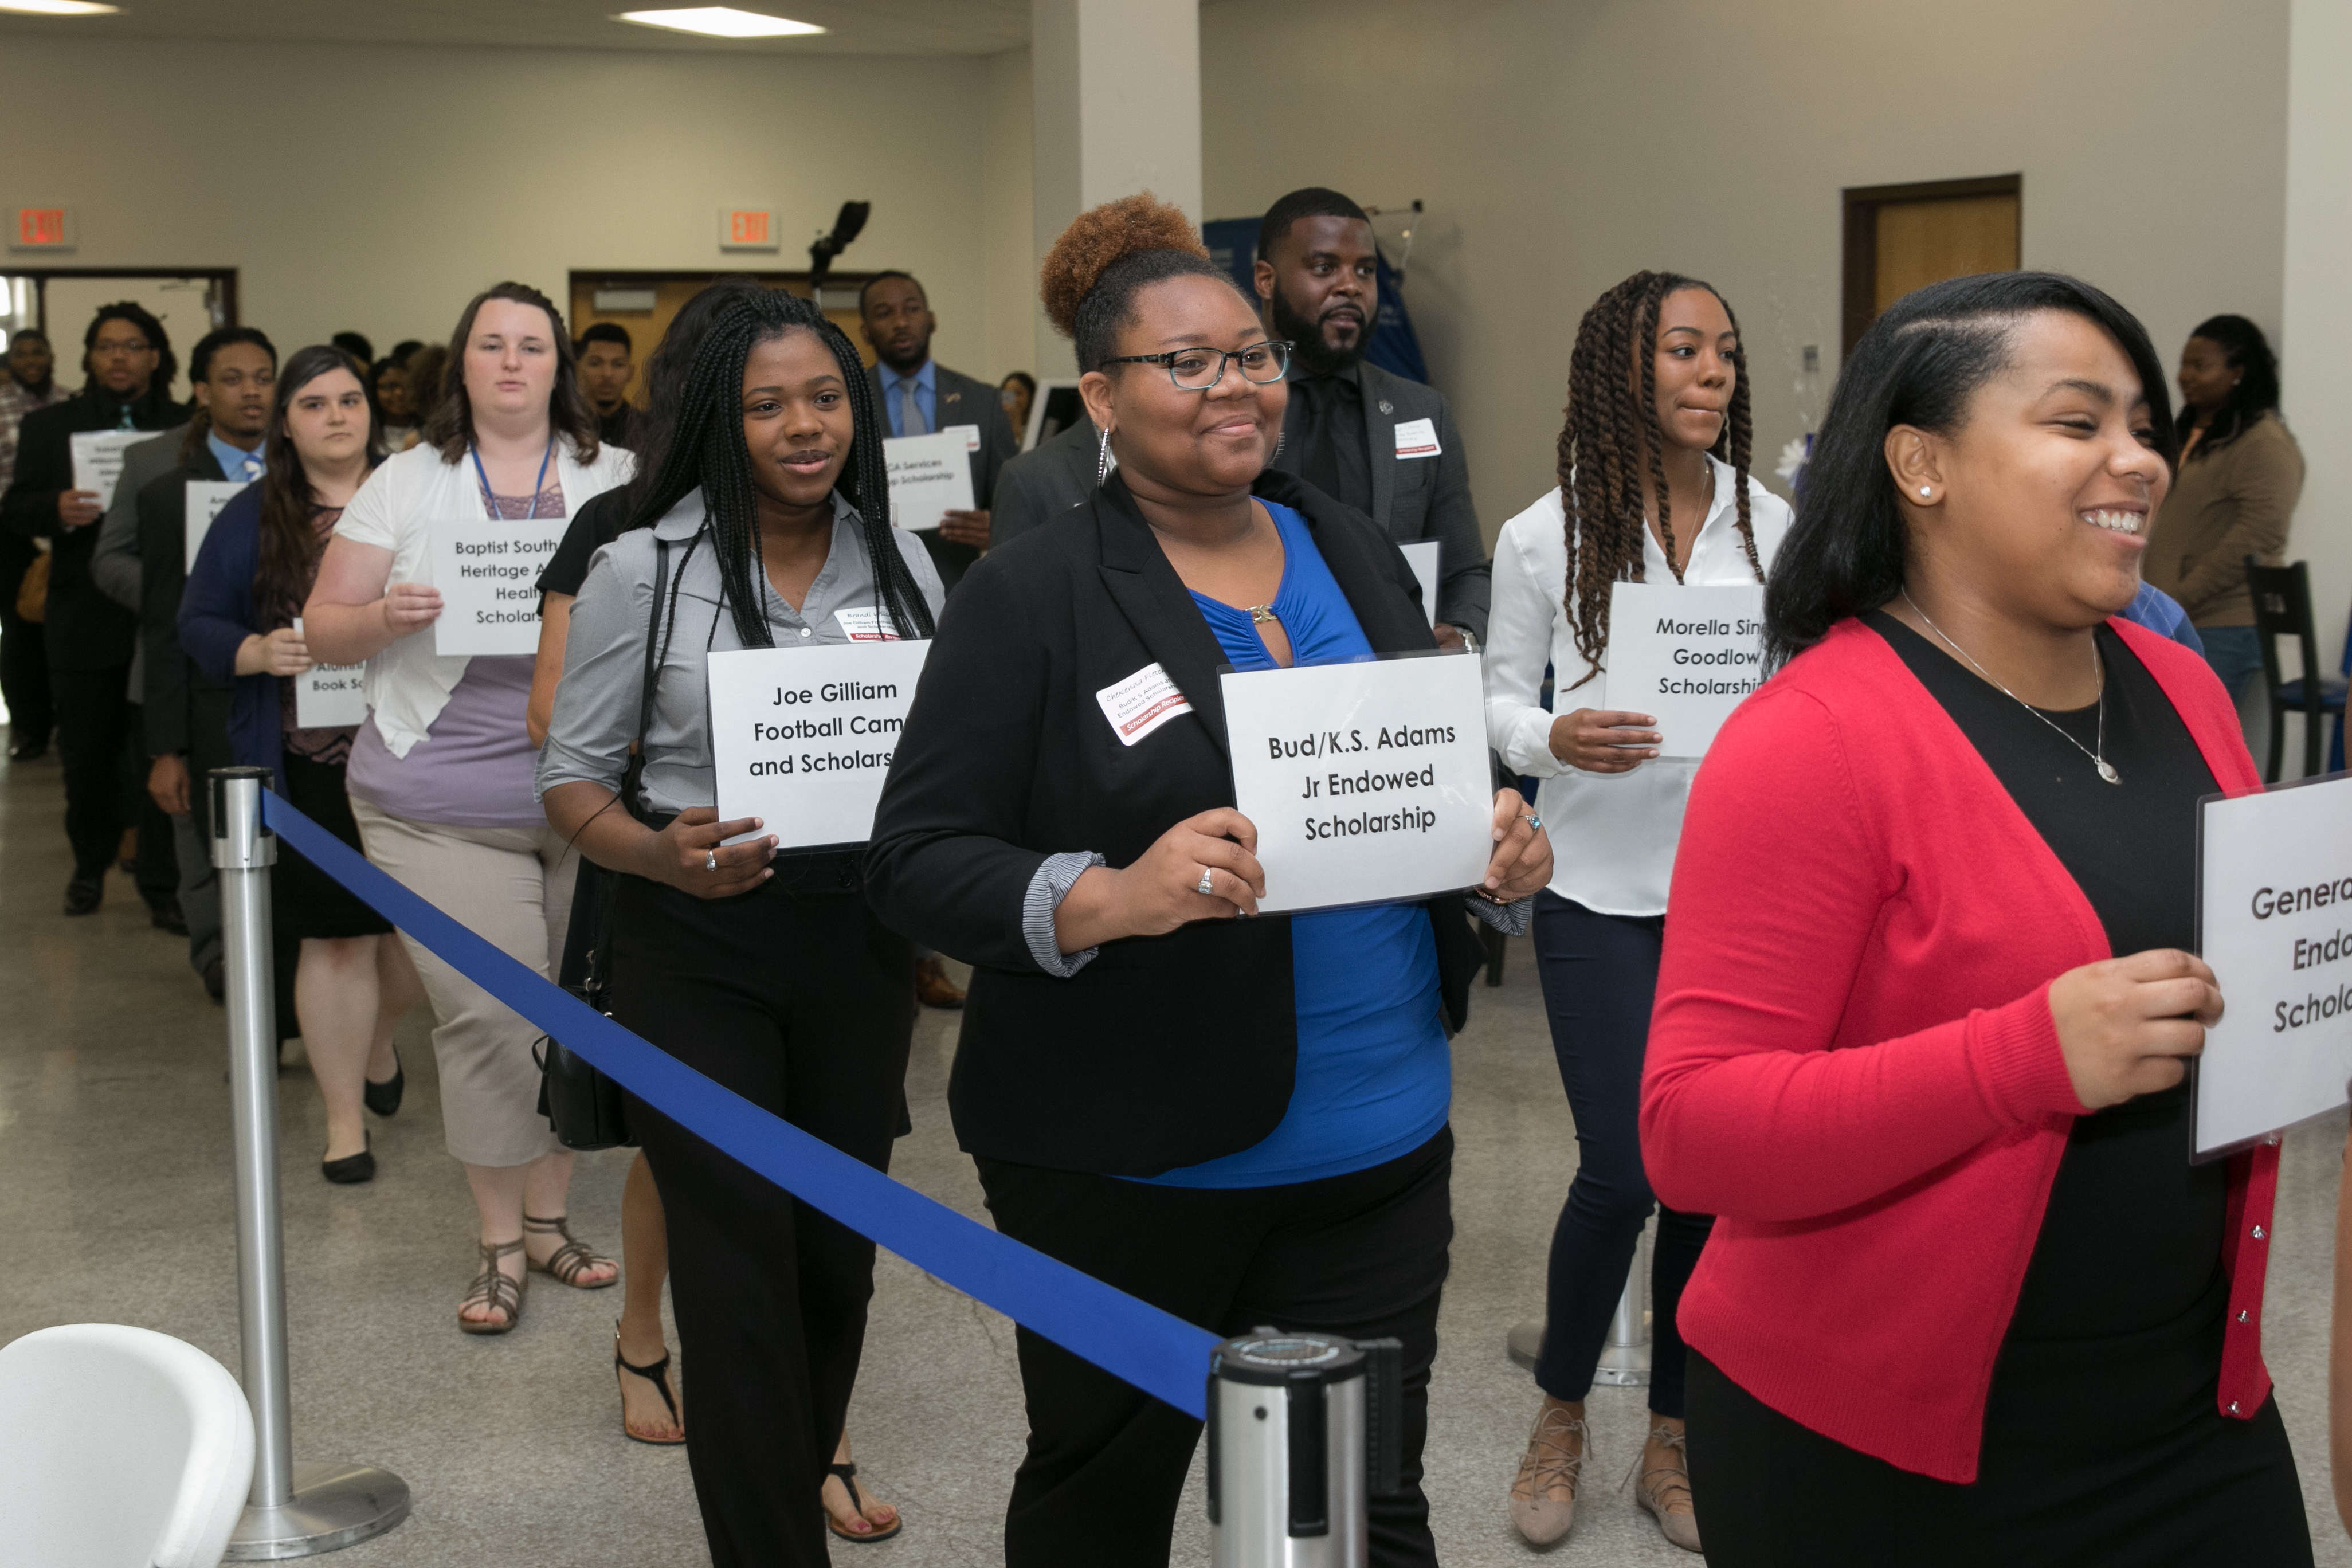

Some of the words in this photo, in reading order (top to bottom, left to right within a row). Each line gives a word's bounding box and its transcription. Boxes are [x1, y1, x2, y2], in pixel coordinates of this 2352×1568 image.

[19, 208, 65, 244] EXIT
[731, 210, 770, 243] EXIT
[456, 541, 508, 556] Baptist
[514, 539, 559, 553] South
[461, 564, 529, 580] Heritage
[1656, 618, 1730, 635] Morella
[312, 680, 346, 691] Book
[773, 687, 813, 705] Joe
[821, 681, 897, 702] Gilliam
[1118, 696, 1138, 709] Bud/K
[1143, 681, 1164, 695] Adams
[1659, 677, 1762, 694] Scholarshi
[1117, 700, 1146, 718] Endowed
[1127, 705, 1161, 731] Scholarship
[754, 717, 842, 741] Football
[1268, 730, 1369, 759] Bud/K.S.
[1377, 725, 1456, 749] Adams
[750, 755, 793, 776] and
[801, 748, 895, 773] Scholars
[1302, 776, 1320, 799] Jr
[1328, 763, 1434, 796] Endowed
[1305, 805, 1436, 840] Scholarship
